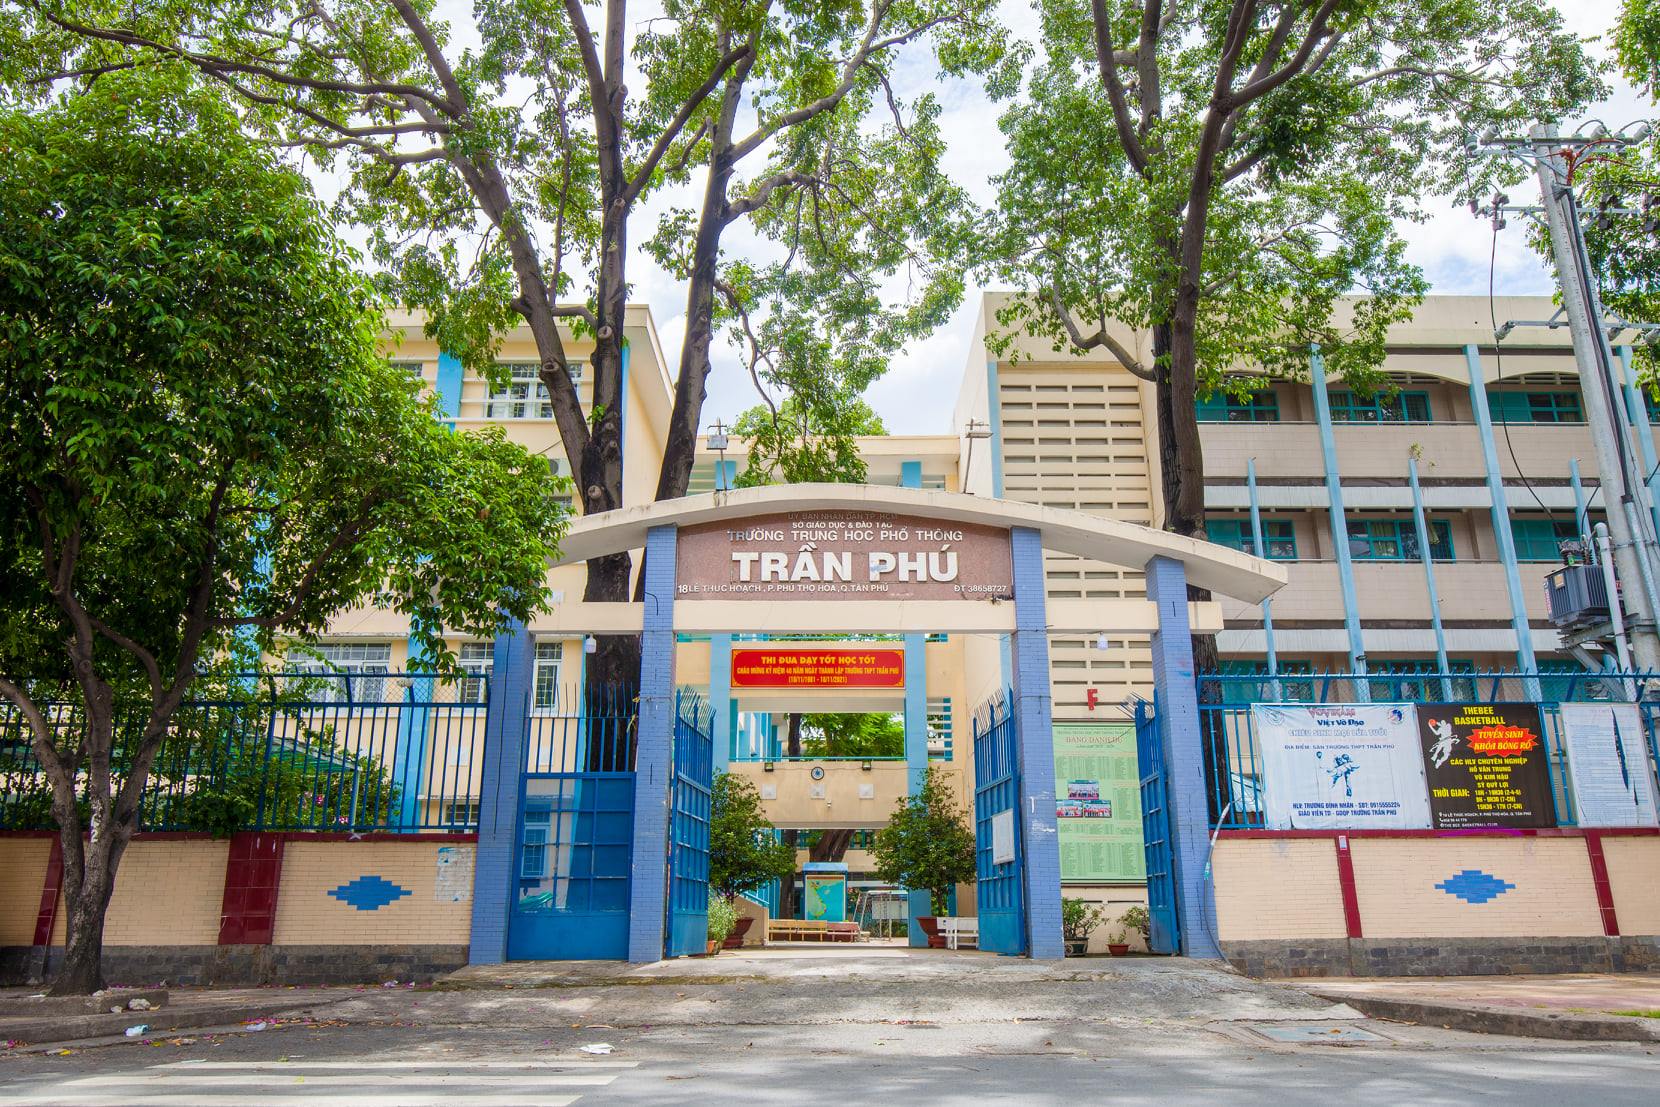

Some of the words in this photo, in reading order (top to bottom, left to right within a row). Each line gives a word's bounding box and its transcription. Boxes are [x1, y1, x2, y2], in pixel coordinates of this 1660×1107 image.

[727, 528, 785, 541] TRƯỜNG
[791, 530, 838, 541] TRUNG
[844, 530, 874, 543] HỌC
[915, 529, 963, 541] THÔNG
[732, 542, 852, 583] TRẦN
[868, 544, 960, 583] PHÚ
[678, 584, 689, 593] 18
[967, 585, 1007, 593] 38658727
[761, 656, 776, 664] THI
[838, 656, 857, 666] HỌC
[1087, 688, 1099, 710] F
[1462, 706, 1494, 715] THEBEE
[1454, 717, 1506, 725] BASKETBALL
[1505, 730, 1524, 738] SINH
[1451, 789, 1471, 797] GIAN:
